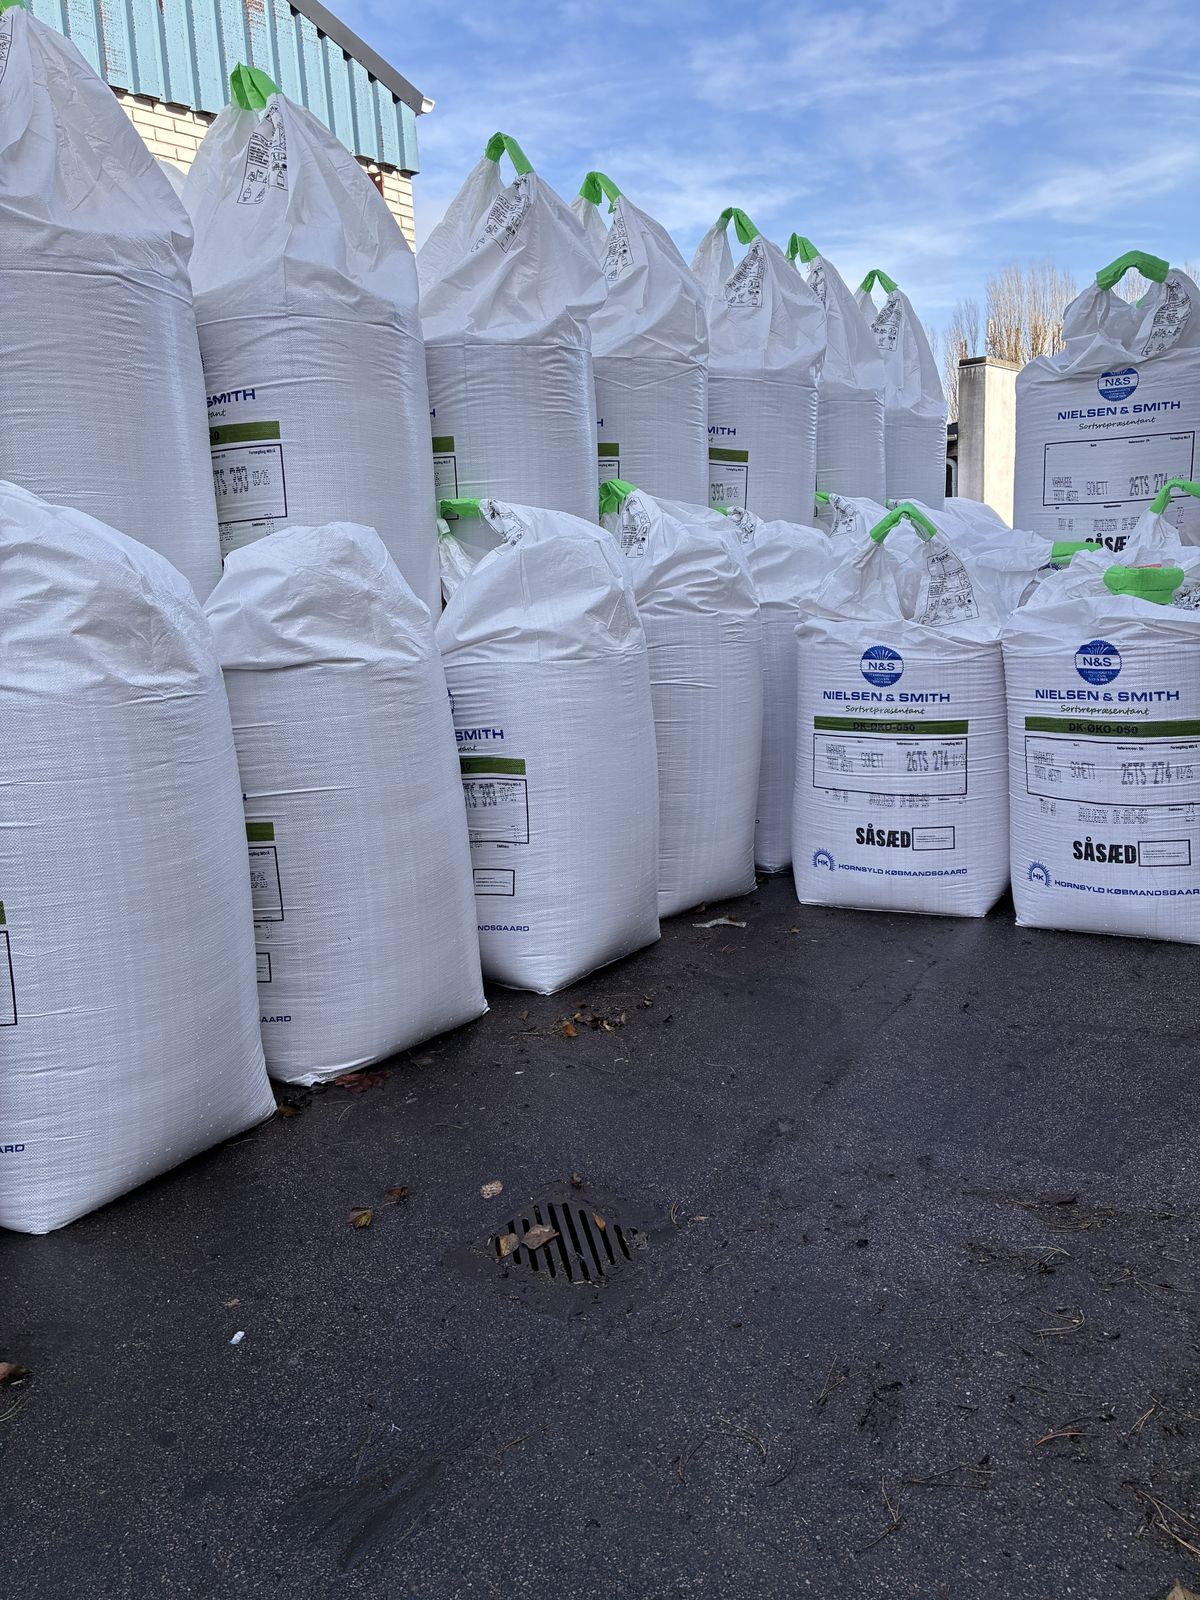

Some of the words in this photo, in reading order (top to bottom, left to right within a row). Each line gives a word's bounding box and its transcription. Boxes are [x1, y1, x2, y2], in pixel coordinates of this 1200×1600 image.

[1105, 376, 1131, 387] N&S
[1057, 407, 1118, 420] NIELSEN
[1120, 406, 1129, 415] &
[1132, 401, 1181, 413] SMITH
[1079, 416, 1156, 430] Sortsrepræsentant
[711, 483, 725, 501] 393
[868, 661, 896, 671] N&S
[1083, 657, 1112, 667] N&S
[823, 690, 883, 702] NIELSEN
[885, 693, 895, 702] &
[899, 693, 951, 702] SMITH
[1035, 689, 1100, 701] NIELSEN
[1103, 692, 1113, 701] &
[1117, 690, 1180, 702] SMITH
[845, 704, 926, 715] Sortsrepræsentant
[1060, 704, 1150, 716] Sortsrepræsentant
[1068, 722, 1139, 735] DK-ØKO-050
[455, 729, 505, 741] SMITH
[906, 750, 929, 772] 26TS
[932, 750, 949, 772] 274
[1152, 761, 1172, 785] 274
[856, 823, 911, 848] SÅSÆD
[1073, 836, 1137, 865] SÅSÆD
[817, 858, 829, 867] HK
[838, 863, 884, 875] HORNSYLD
[885, 867, 968, 877] KØBMANDSGAARD
[1032, 872, 1044, 882] HK
[1054, 879, 1105, 894] HORNSYLD
[477, 924, 530, 932] NDSGAARD
[261, 1015, 292, 1023] AARD
